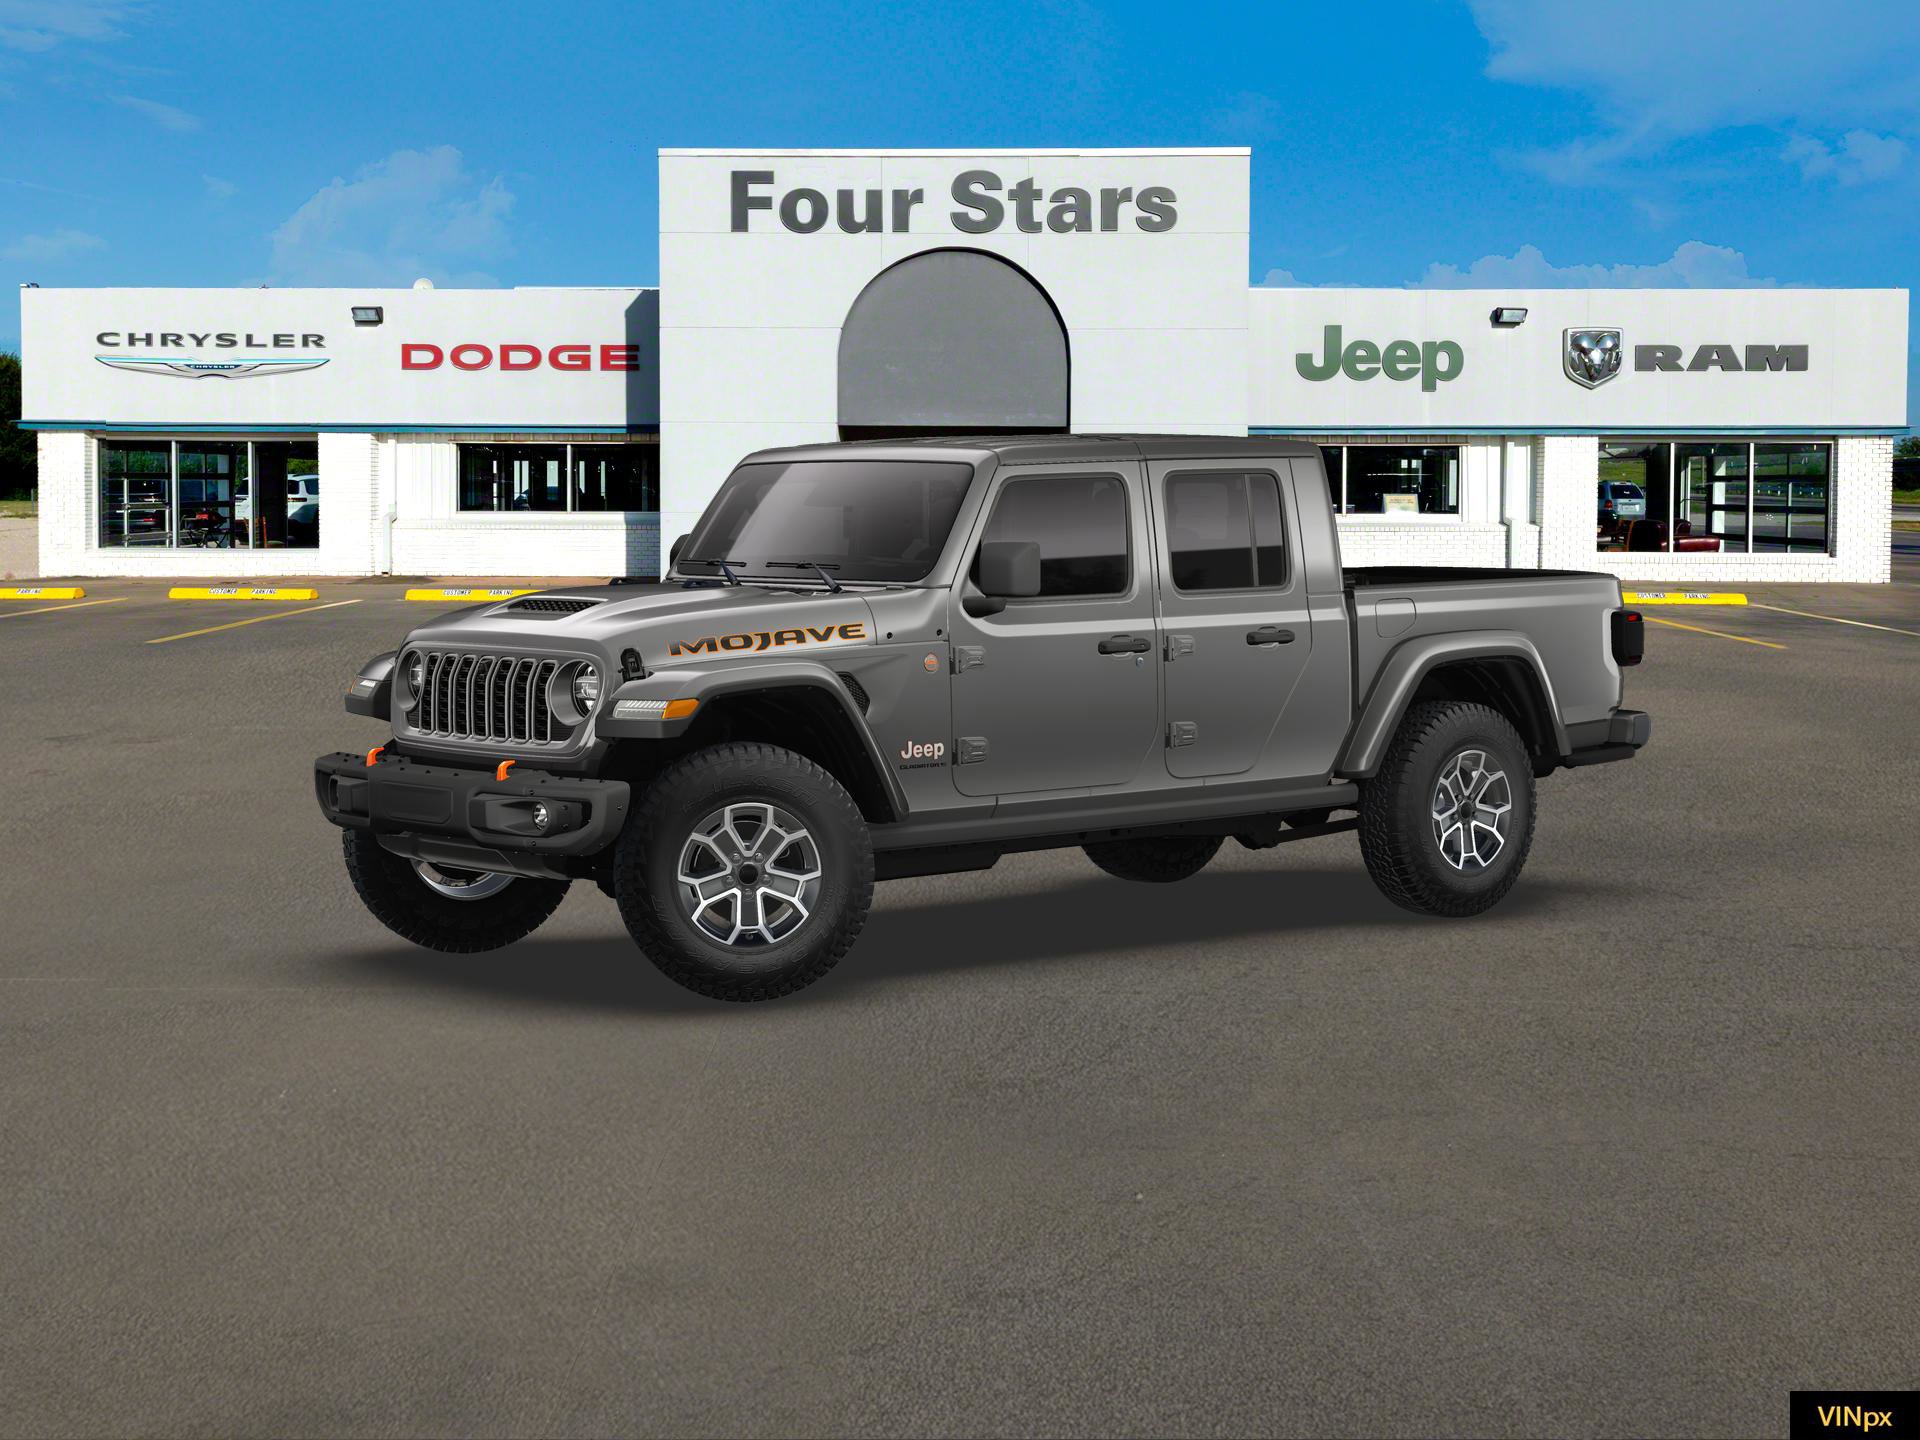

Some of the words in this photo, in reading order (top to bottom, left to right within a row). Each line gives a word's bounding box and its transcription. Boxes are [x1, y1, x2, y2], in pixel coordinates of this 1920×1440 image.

[730, 170, 924, 233] Four
[950, 169, 1178, 234] Stars
[96, 332, 327, 348] CHRYSLER
[401, 343, 640, 371] DODGE
[1295, 324, 1464, 392] Jeep
[1634, 344, 1809, 372] RAM
[669, 622, 867, 656] MOJAVE
[900, 740, 945, 760] Jeep
